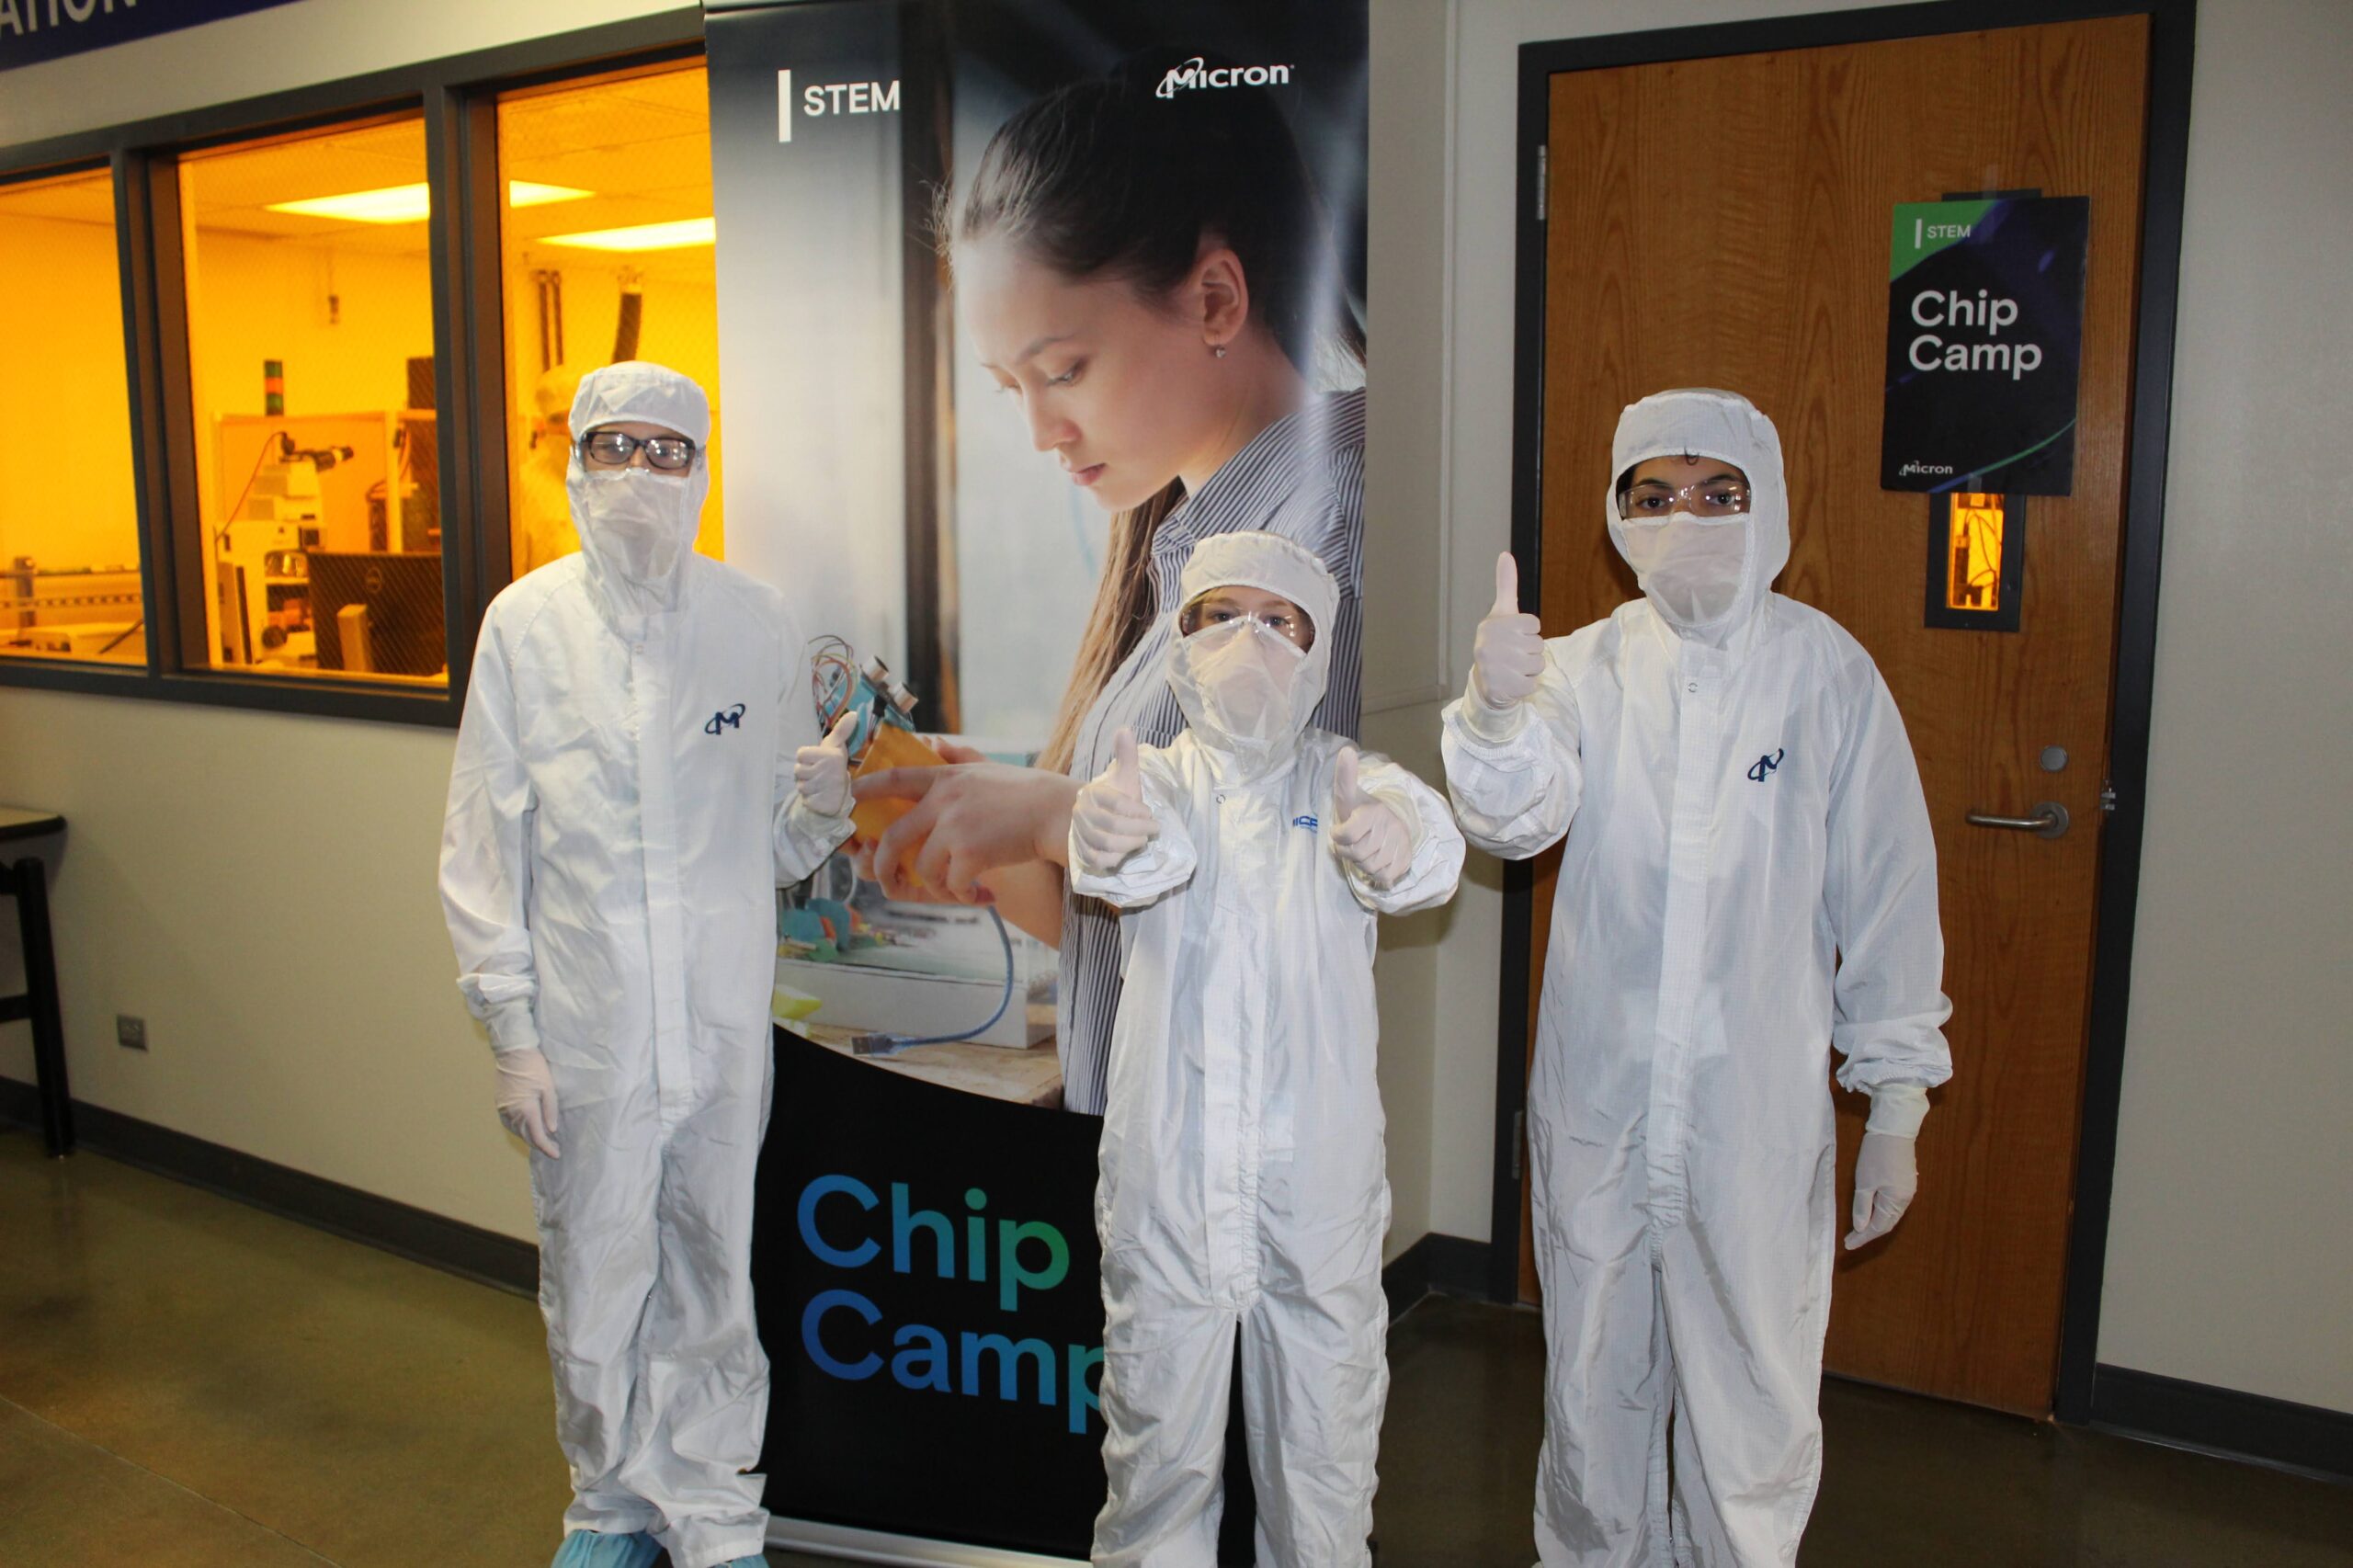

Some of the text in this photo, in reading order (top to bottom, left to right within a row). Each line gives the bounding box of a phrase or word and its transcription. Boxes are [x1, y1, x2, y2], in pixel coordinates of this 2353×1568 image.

[0, 0, 136, 35] ATIO
[1155, 56, 1290, 98] Micron
[803, 80, 900, 117] STEM
[1927, 224, 1972, 239] STEM
[1911, 289, 2018, 335] Chip
[1908, 334, 2042, 381] Camp
[1899, 460, 1953, 476] Micron
[797, 1174, 1070, 1312] Chip
